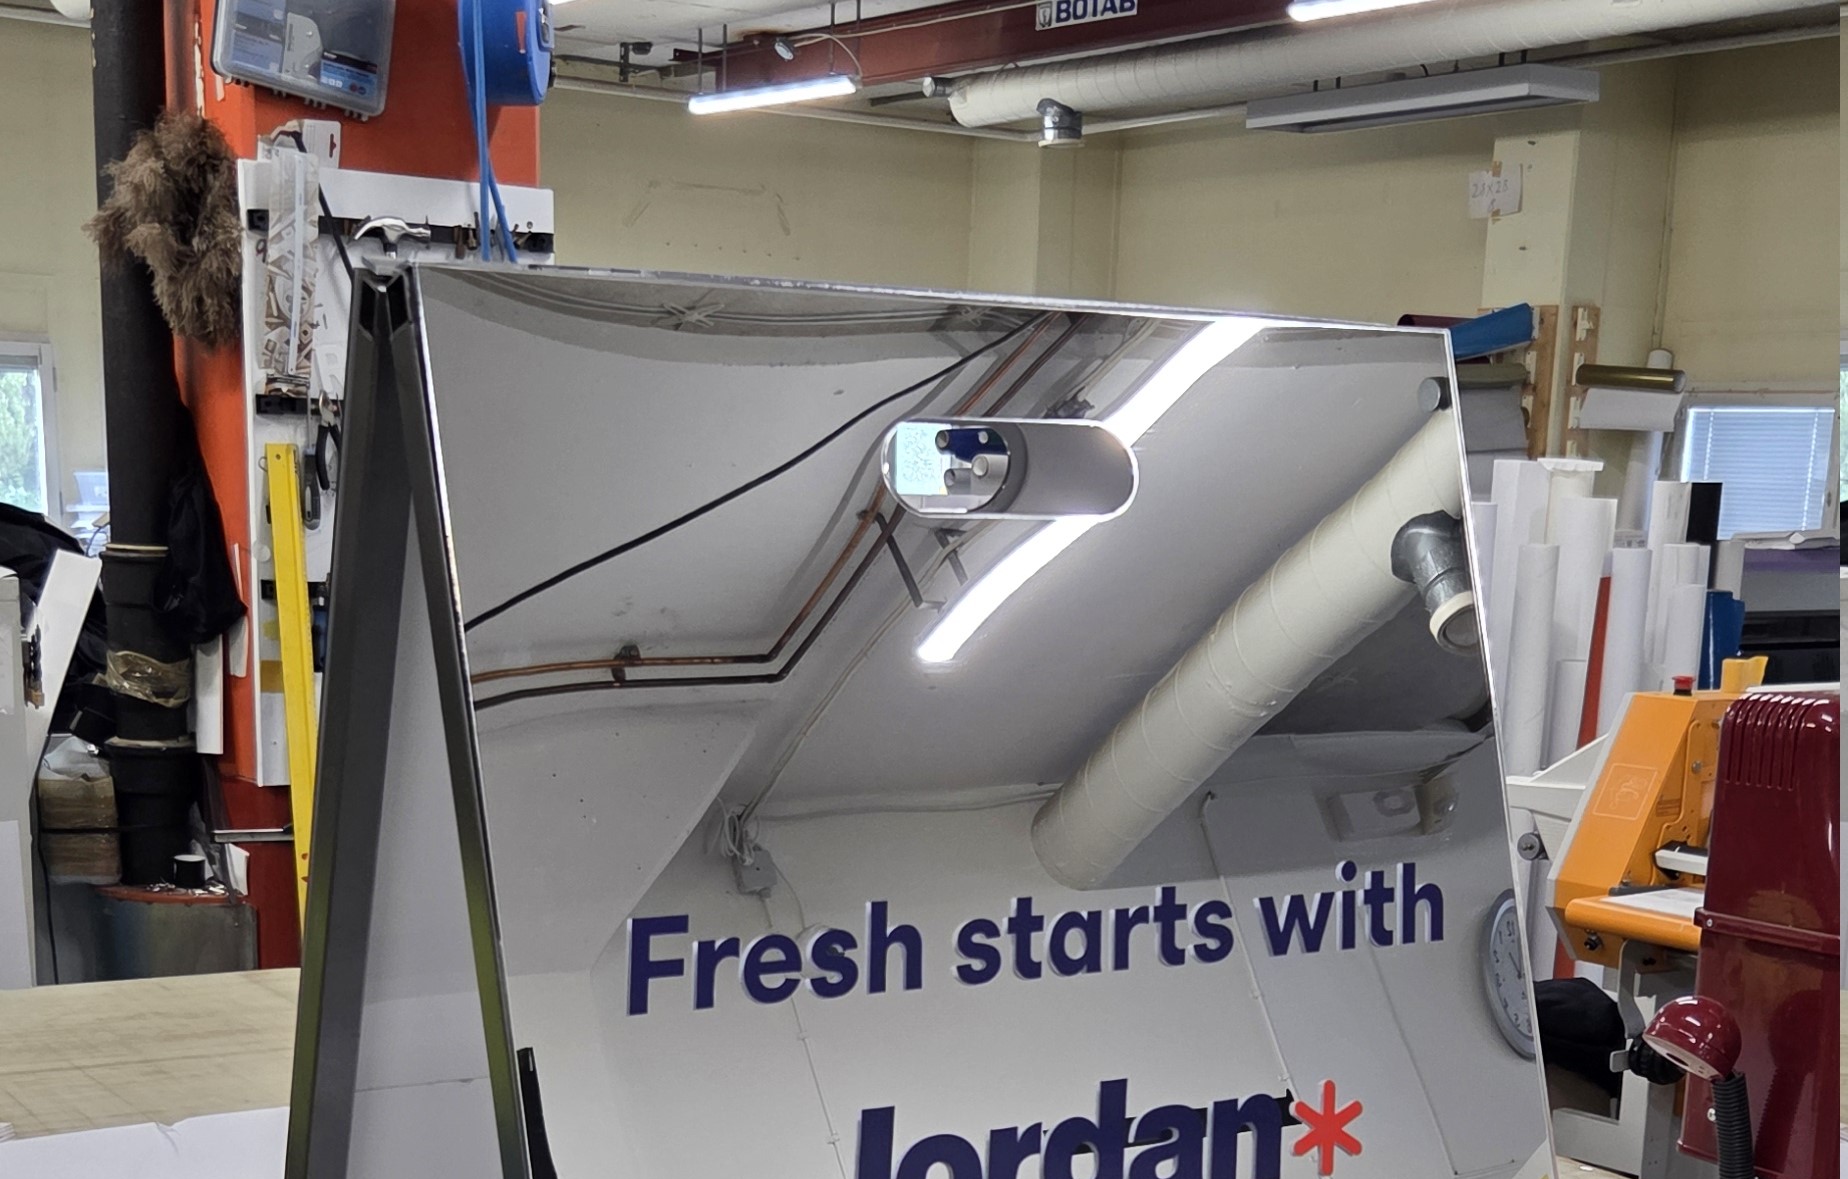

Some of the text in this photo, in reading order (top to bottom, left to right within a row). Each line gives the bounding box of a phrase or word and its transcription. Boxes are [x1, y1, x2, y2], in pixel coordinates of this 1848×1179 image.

[626, 860, 1445, 1016] Fresh starts with
